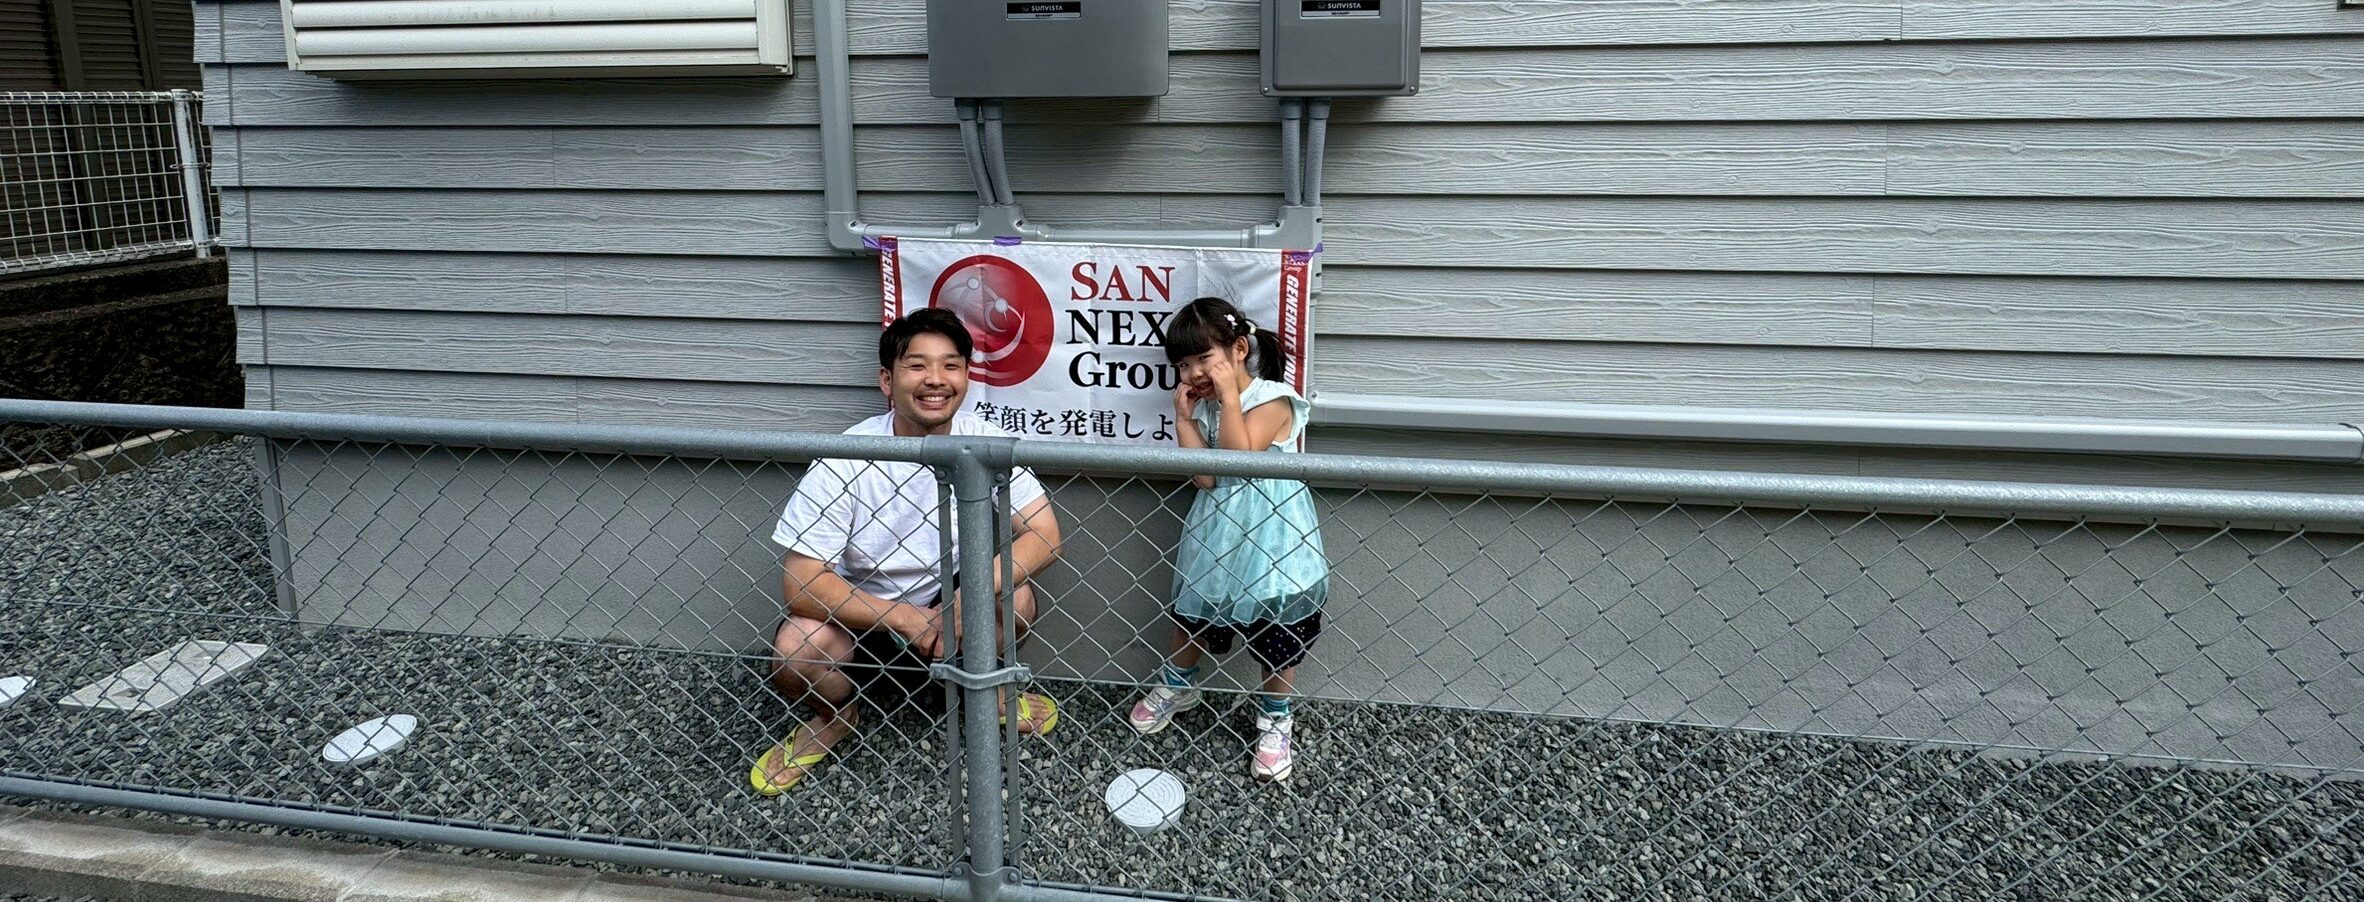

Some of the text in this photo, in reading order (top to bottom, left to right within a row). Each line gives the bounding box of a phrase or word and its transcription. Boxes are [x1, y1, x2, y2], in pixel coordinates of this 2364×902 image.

[1071, 261, 1175, 303] SAN
[1065, 309, 1173, 347] NEX
[1284, 273, 1299, 353] GENERATE
[1069, 351, 1181, 391] Grou
[1283, 352, 1297, 390] YOU
[973, 401, 1174, 441] 笑顔を発電しよ
